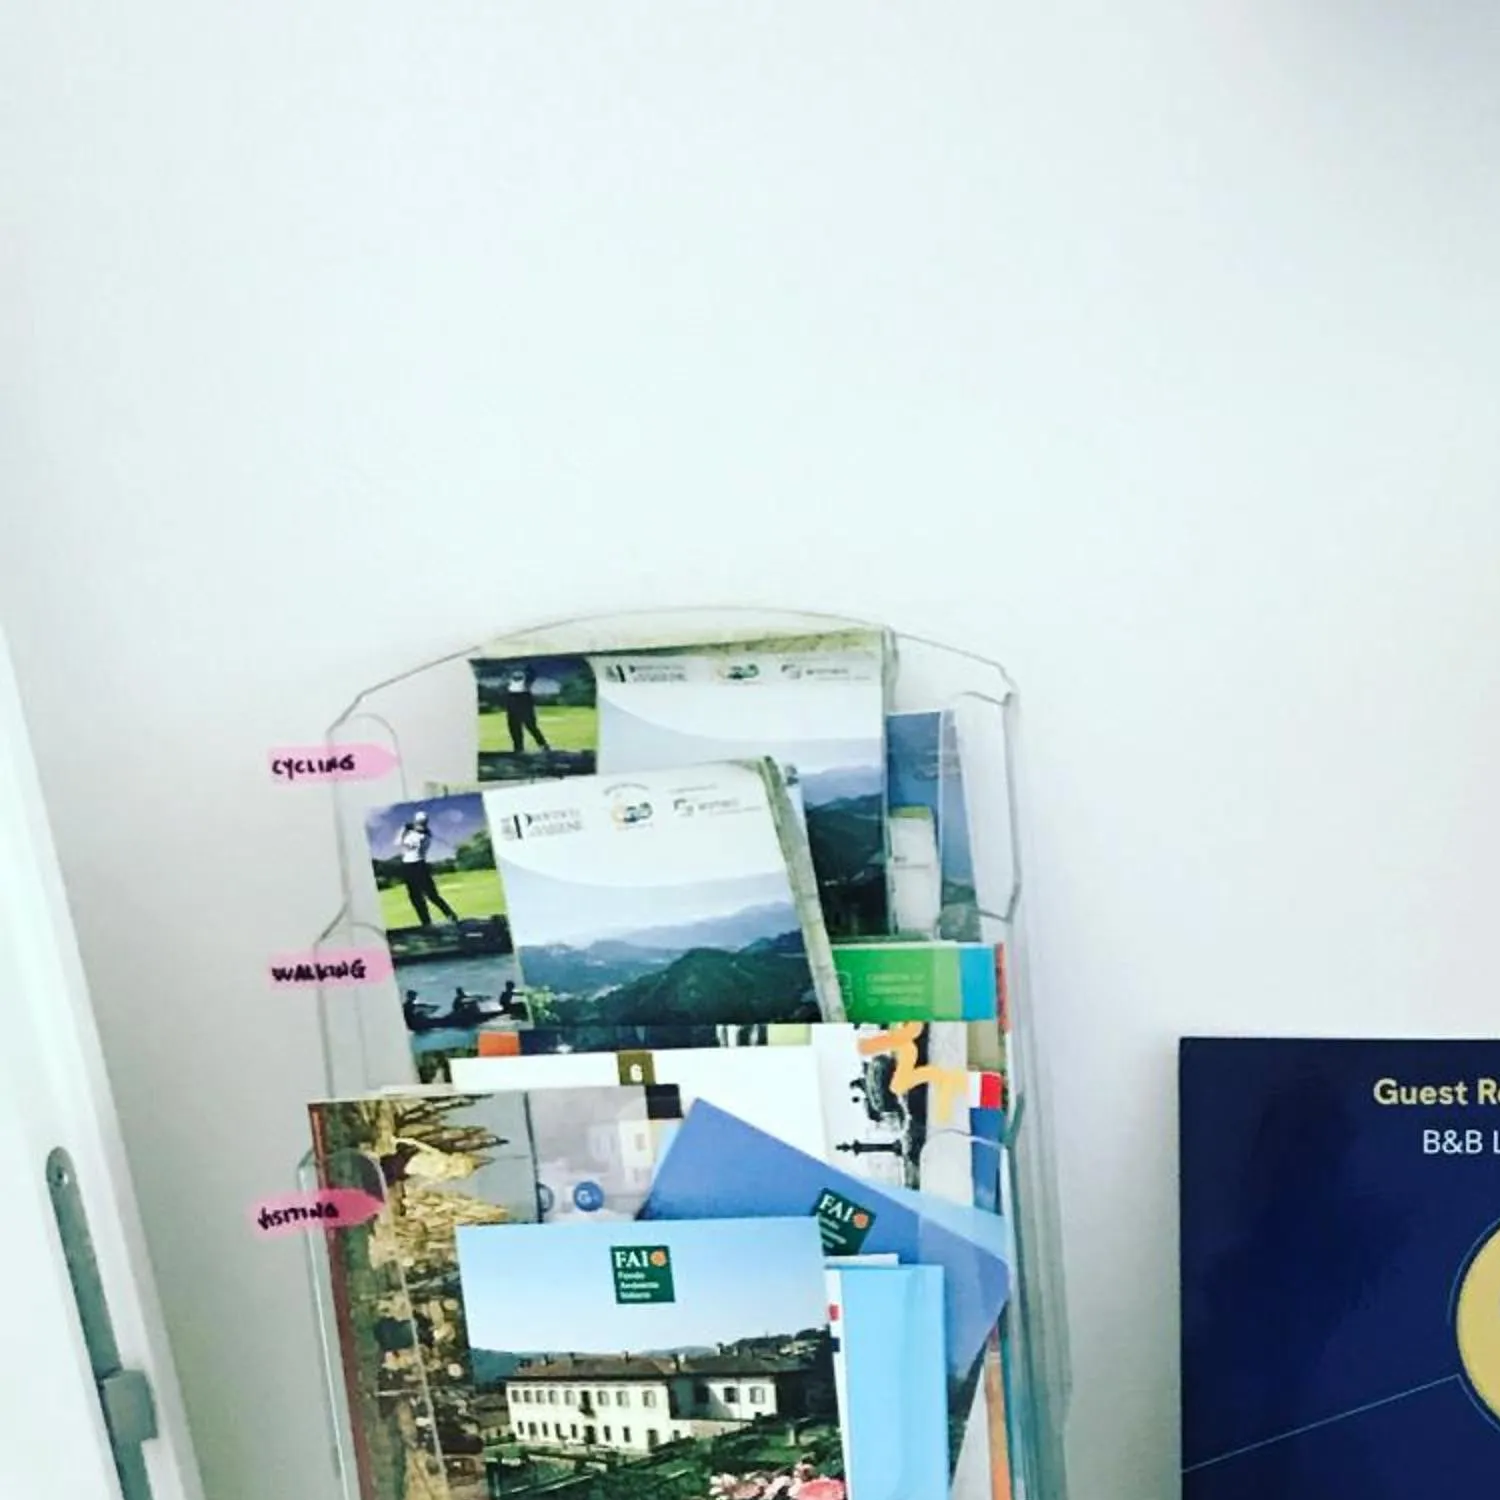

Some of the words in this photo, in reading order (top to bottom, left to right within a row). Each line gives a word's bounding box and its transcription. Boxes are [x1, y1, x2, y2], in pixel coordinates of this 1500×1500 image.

[271, 753, 356, 780] CYCLING
[271, 958, 367, 982] WALKING
[1373, 1078, 1468, 1105] Guest
[1422, 1130, 1484, 1155] B&B
[615, 1249, 649, 1269] FAI
